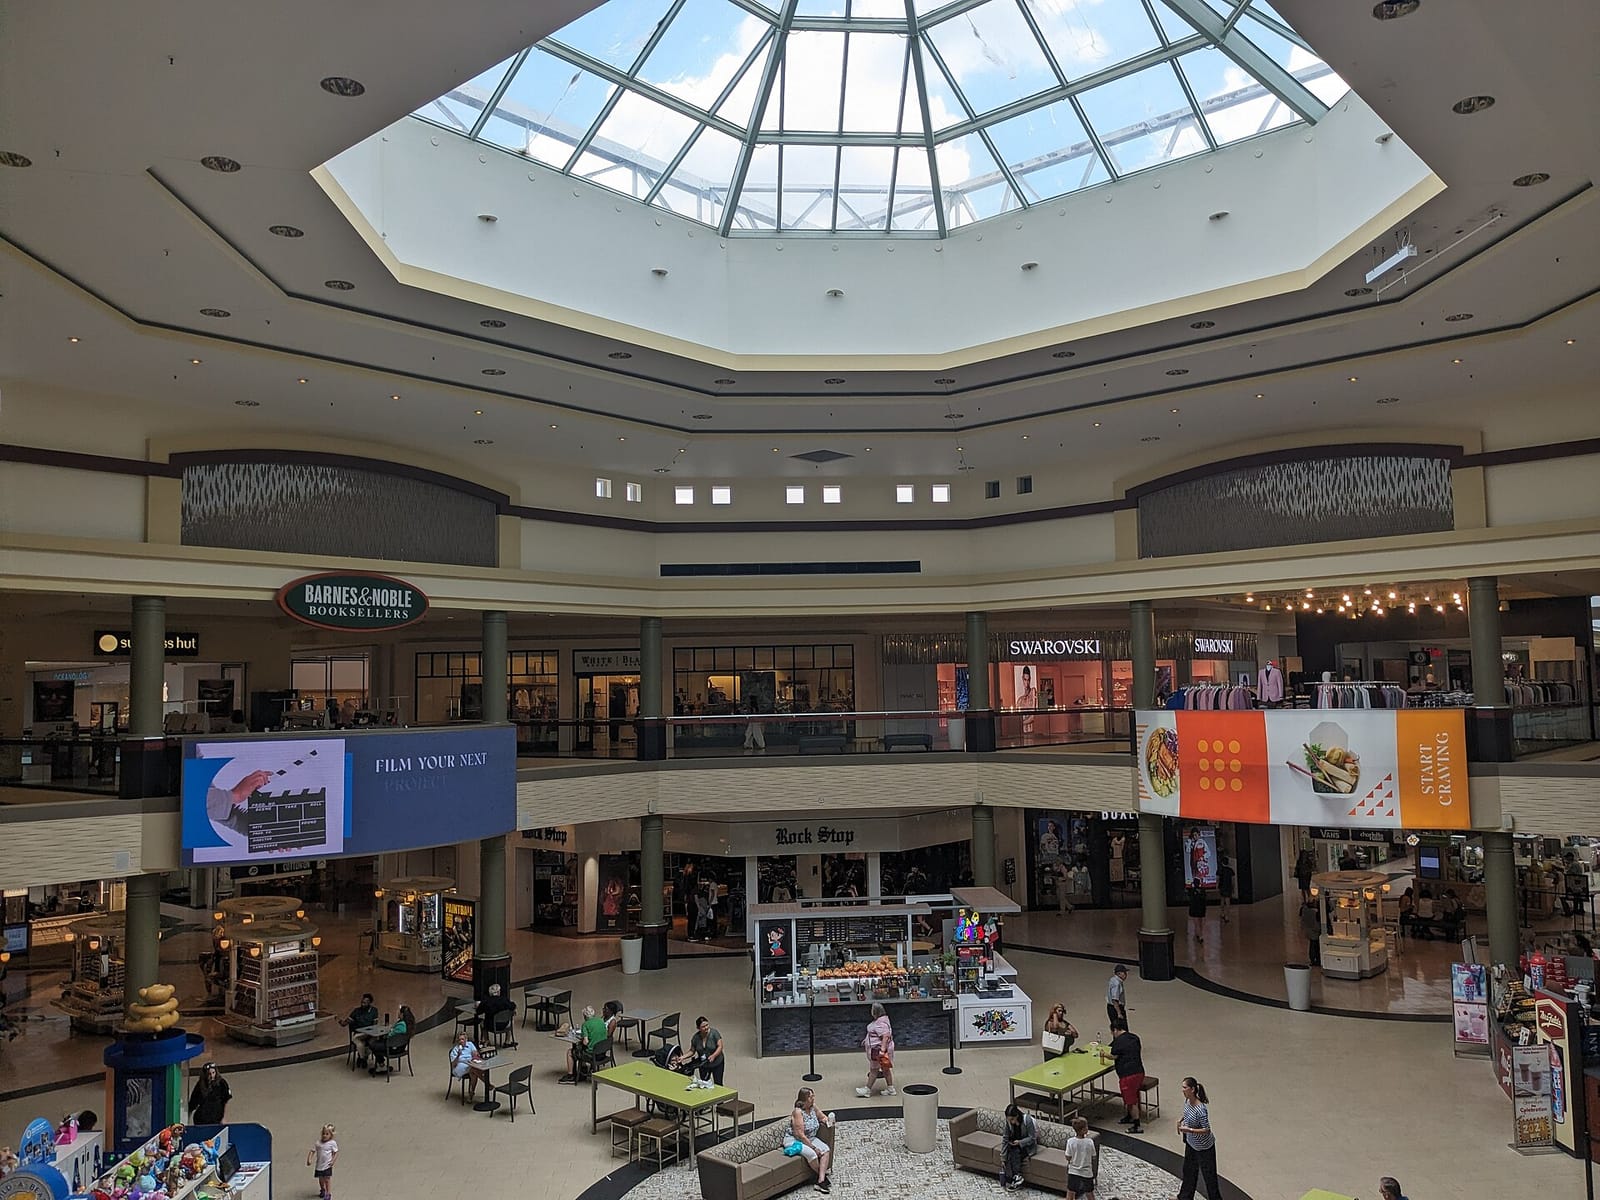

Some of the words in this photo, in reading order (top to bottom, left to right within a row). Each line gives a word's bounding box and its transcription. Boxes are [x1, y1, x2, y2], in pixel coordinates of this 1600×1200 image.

[309, 606, 409, 619] BOOKSELLERS
[176, 635, 197, 649] hut
[1010, 640, 1101, 655] SWAROVSKI
[1195, 638, 1233, 653] SWAROVSKI
[622, 655, 641, 664] BLA
[375, 757, 412, 773] FILM
[418, 754, 455, 770] YOUR
[460, 752, 488, 767] NEXT
[1419, 743, 1434, 795] START
[1436, 731, 1453, 807] CRAVING
[544, 826, 568, 847] Stop
[775, 826, 812, 845] Rock
[817, 825, 854, 848] Stop
[1320, 829, 1341, 839] VANS
[445, 901, 473, 917] PAINTBALL
[1519, 1106, 1548, 1115] Celebration
